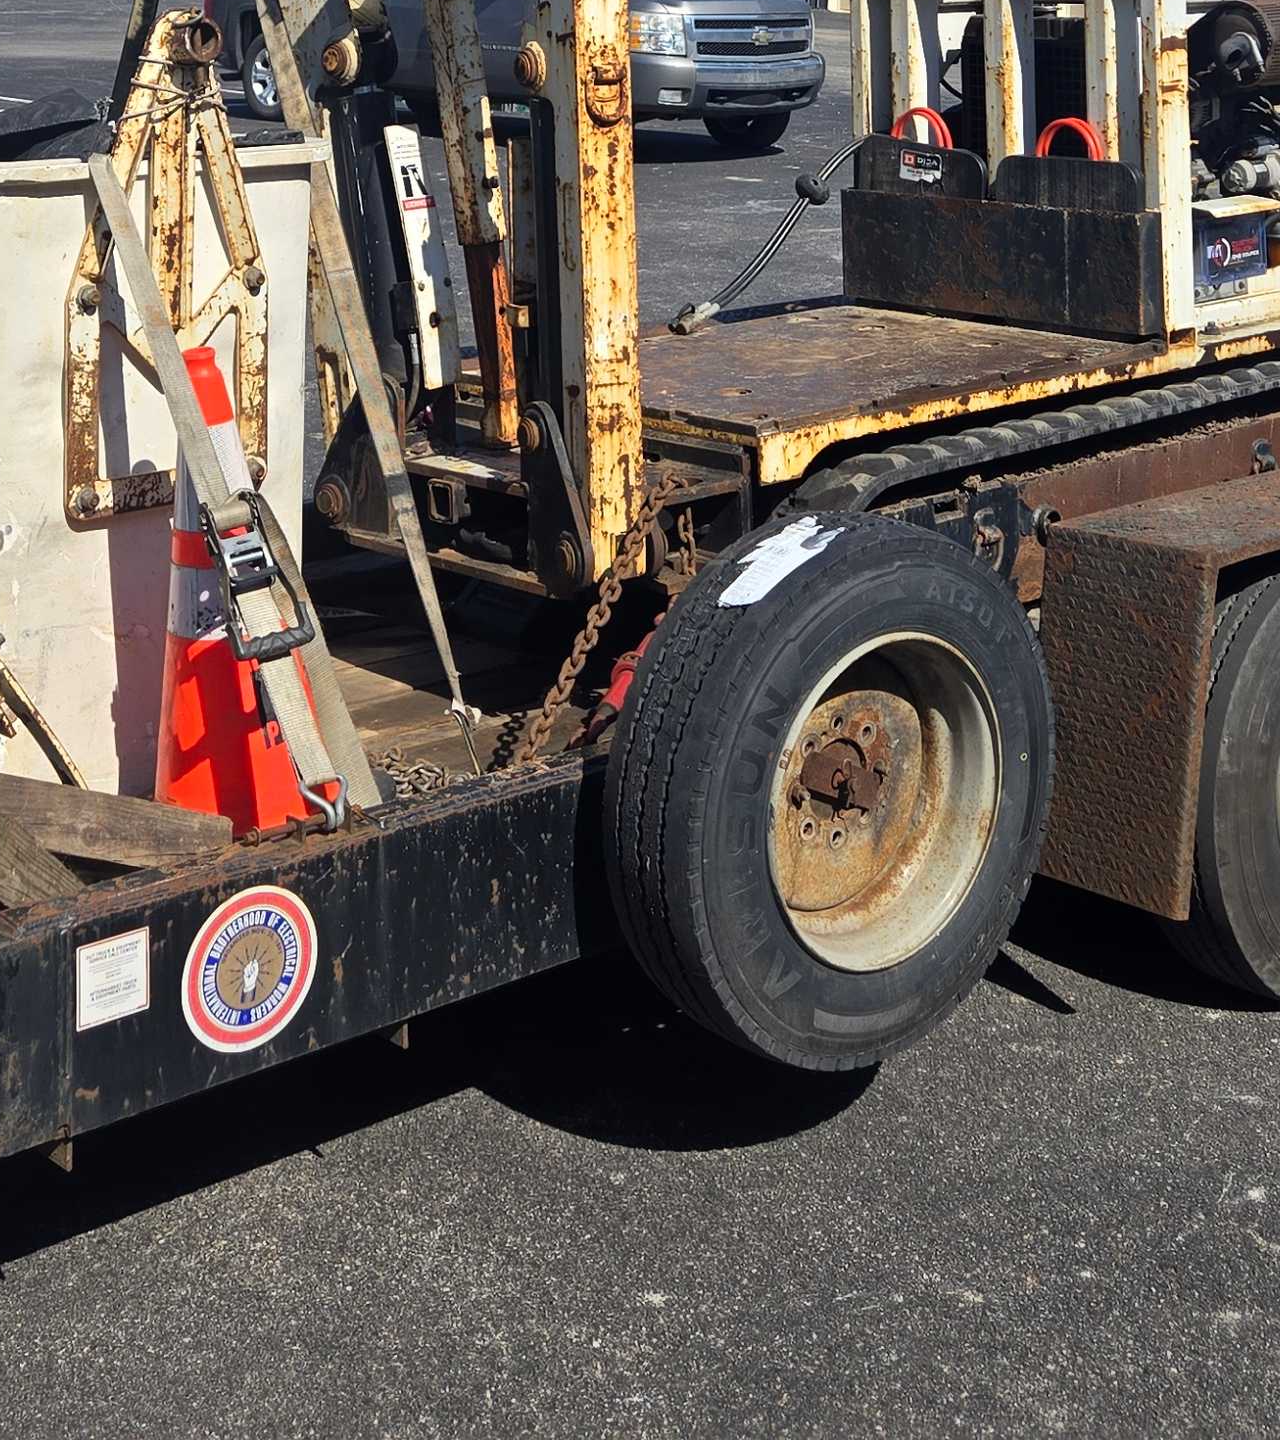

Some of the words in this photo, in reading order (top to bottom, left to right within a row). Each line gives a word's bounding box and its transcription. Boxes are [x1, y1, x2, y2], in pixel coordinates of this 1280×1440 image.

[210, 910, 267, 959] BROTHERHOOD
[267, 911, 281, 928] OF
[276, 920, 298, 982] ELECTRICAL
[203, 962, 242, 1025] INTERNATIONAL
[250, 981, 289, 1022] WORKERS
